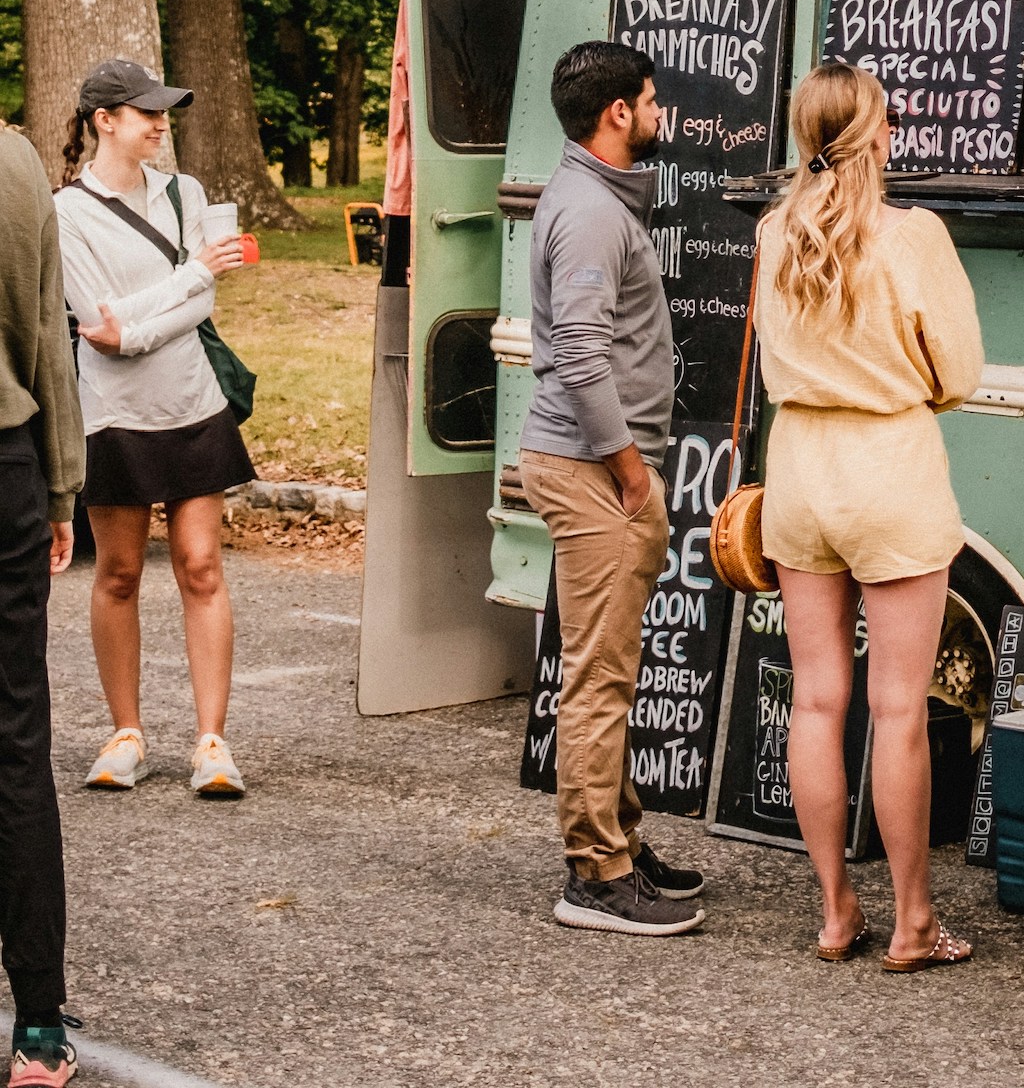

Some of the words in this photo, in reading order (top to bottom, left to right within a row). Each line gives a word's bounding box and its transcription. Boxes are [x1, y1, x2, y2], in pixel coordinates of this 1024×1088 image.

[857, 52, 976, 83] SPECIAL
[883, 87, 1001, 120] SCIUTTO
[683, 117, 713, 146] egg
[722, 122, 767, 151] cheese
[950, 123, 1014, 163] PESTO
[681, 170, 707, 192] egg
[685, 238, 710, 259] egg
[670, 297, 696, 318] egg
[707, 296, 750, 318] chees
[635, 665, 712, 695] DBREW
[627, 696, 704, 733] LENDED
[664, 737, 704, 790] TEA
